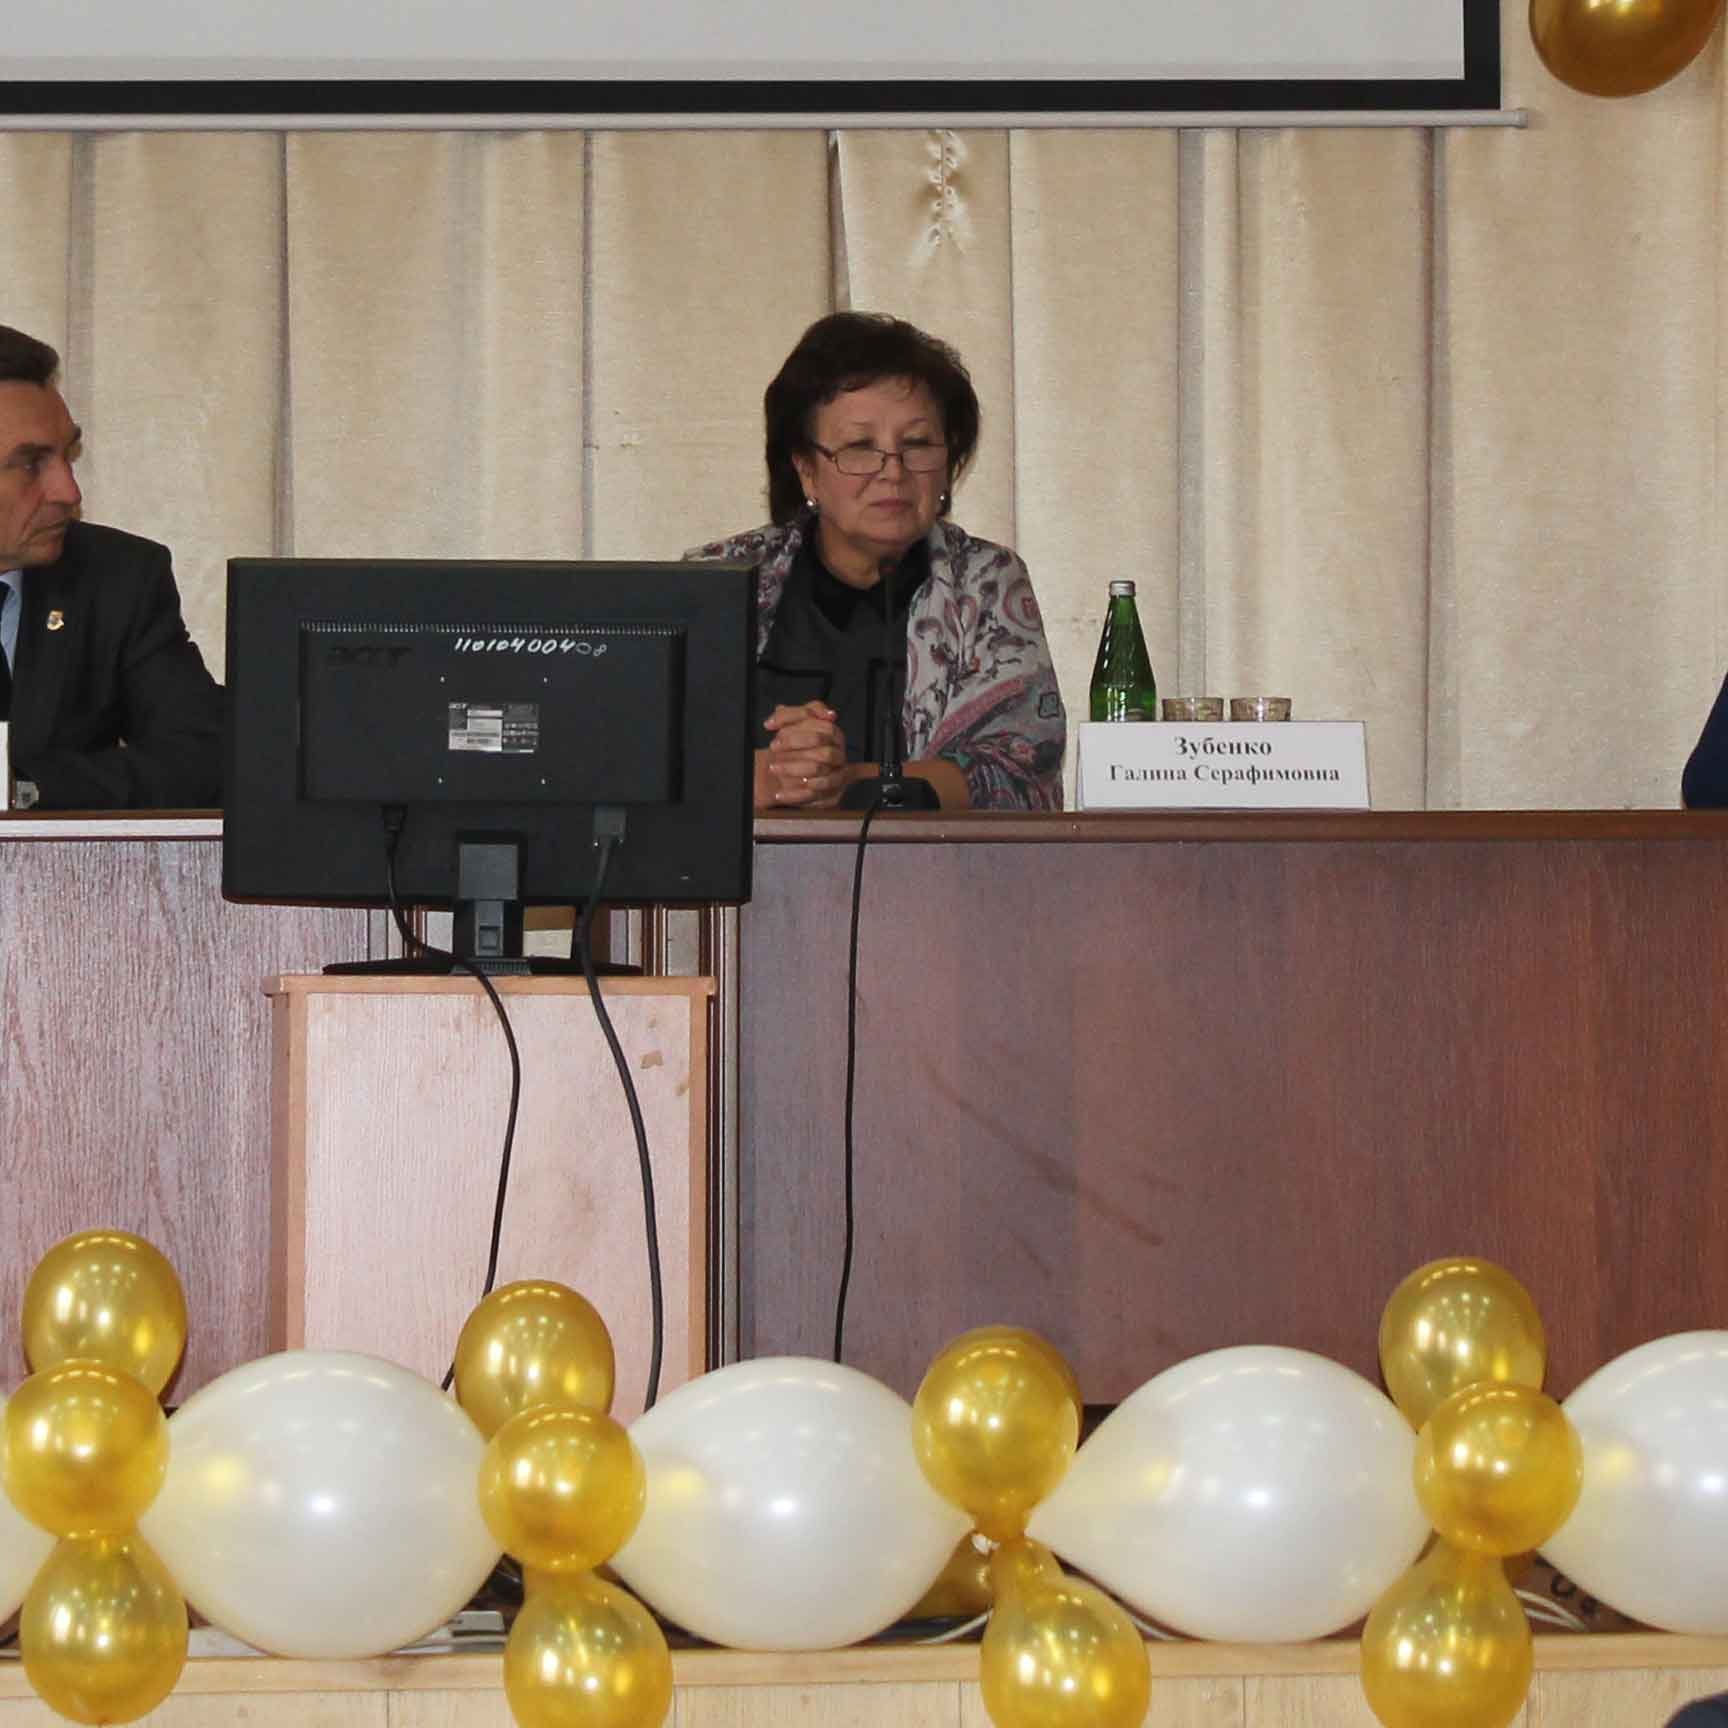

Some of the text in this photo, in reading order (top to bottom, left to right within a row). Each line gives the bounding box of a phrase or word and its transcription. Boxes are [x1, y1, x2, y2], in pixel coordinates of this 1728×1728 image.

[1174, 736, 1273, 761] Зубенко
[1109, 764, 1341, 786] Галина Серафимовна
